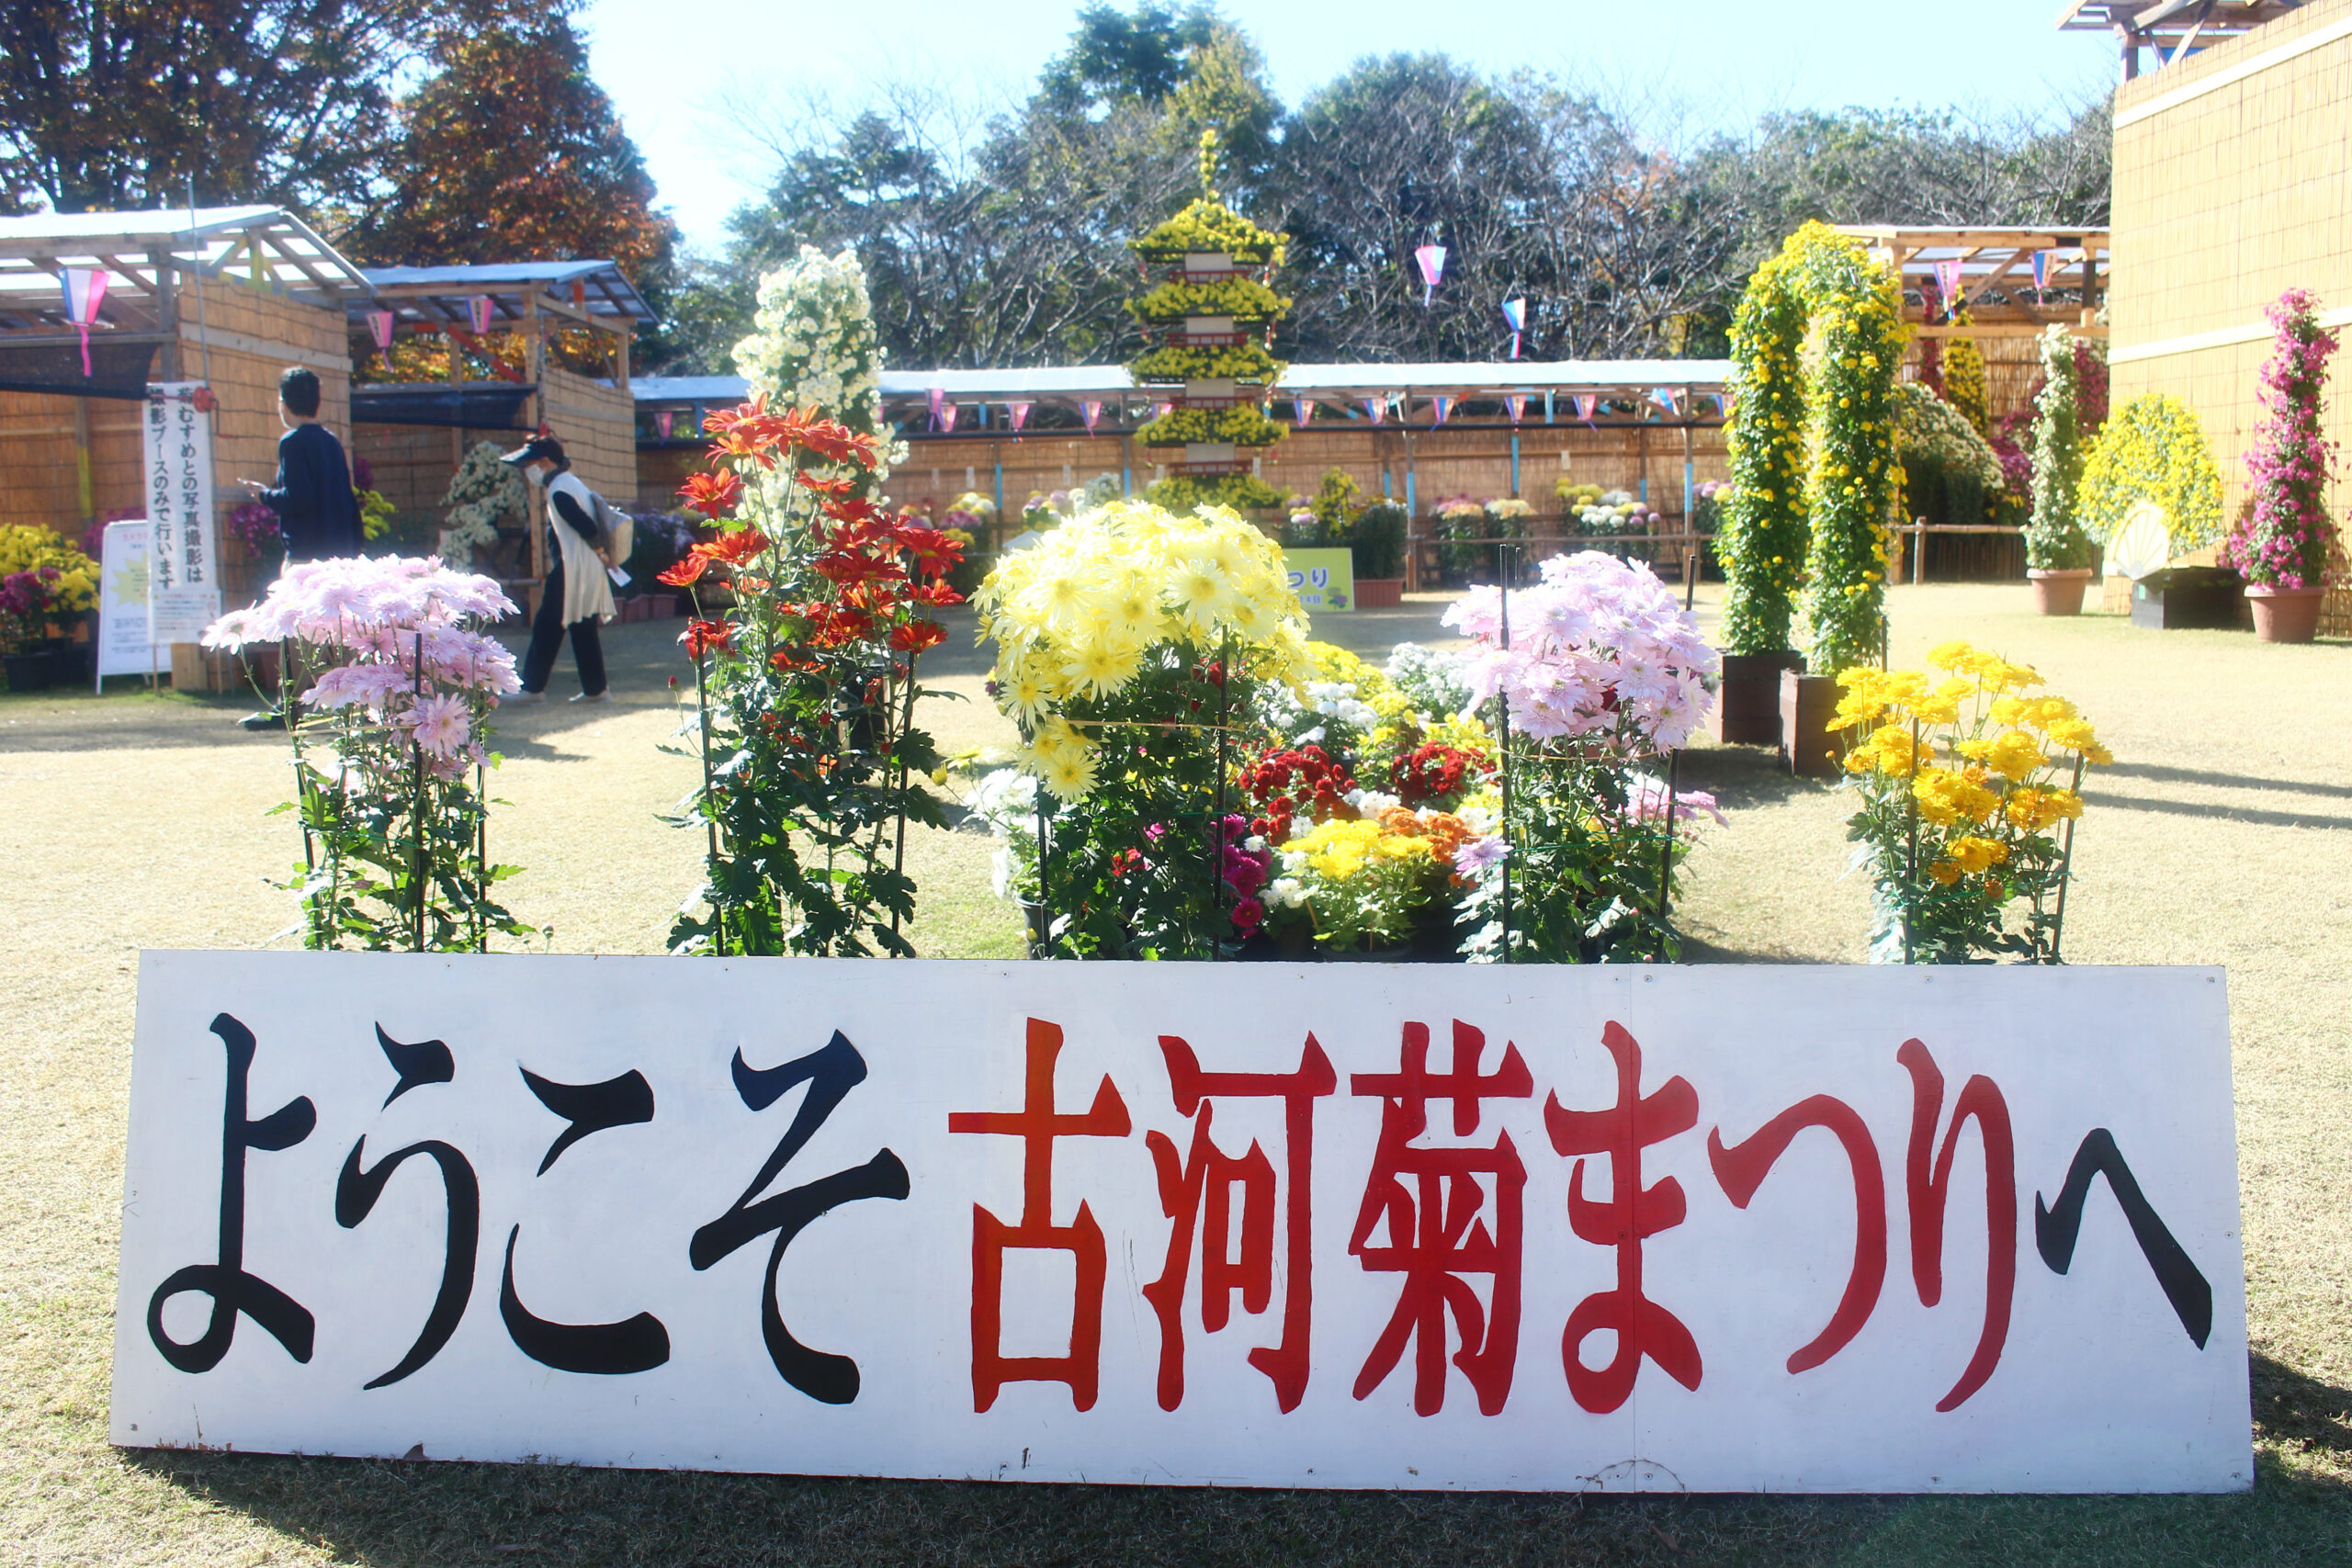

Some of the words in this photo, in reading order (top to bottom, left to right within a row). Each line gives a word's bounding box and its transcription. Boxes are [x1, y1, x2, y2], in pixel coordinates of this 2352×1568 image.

[148, 1012, 2212, 1416] ようこそ古河菊まつりへ
